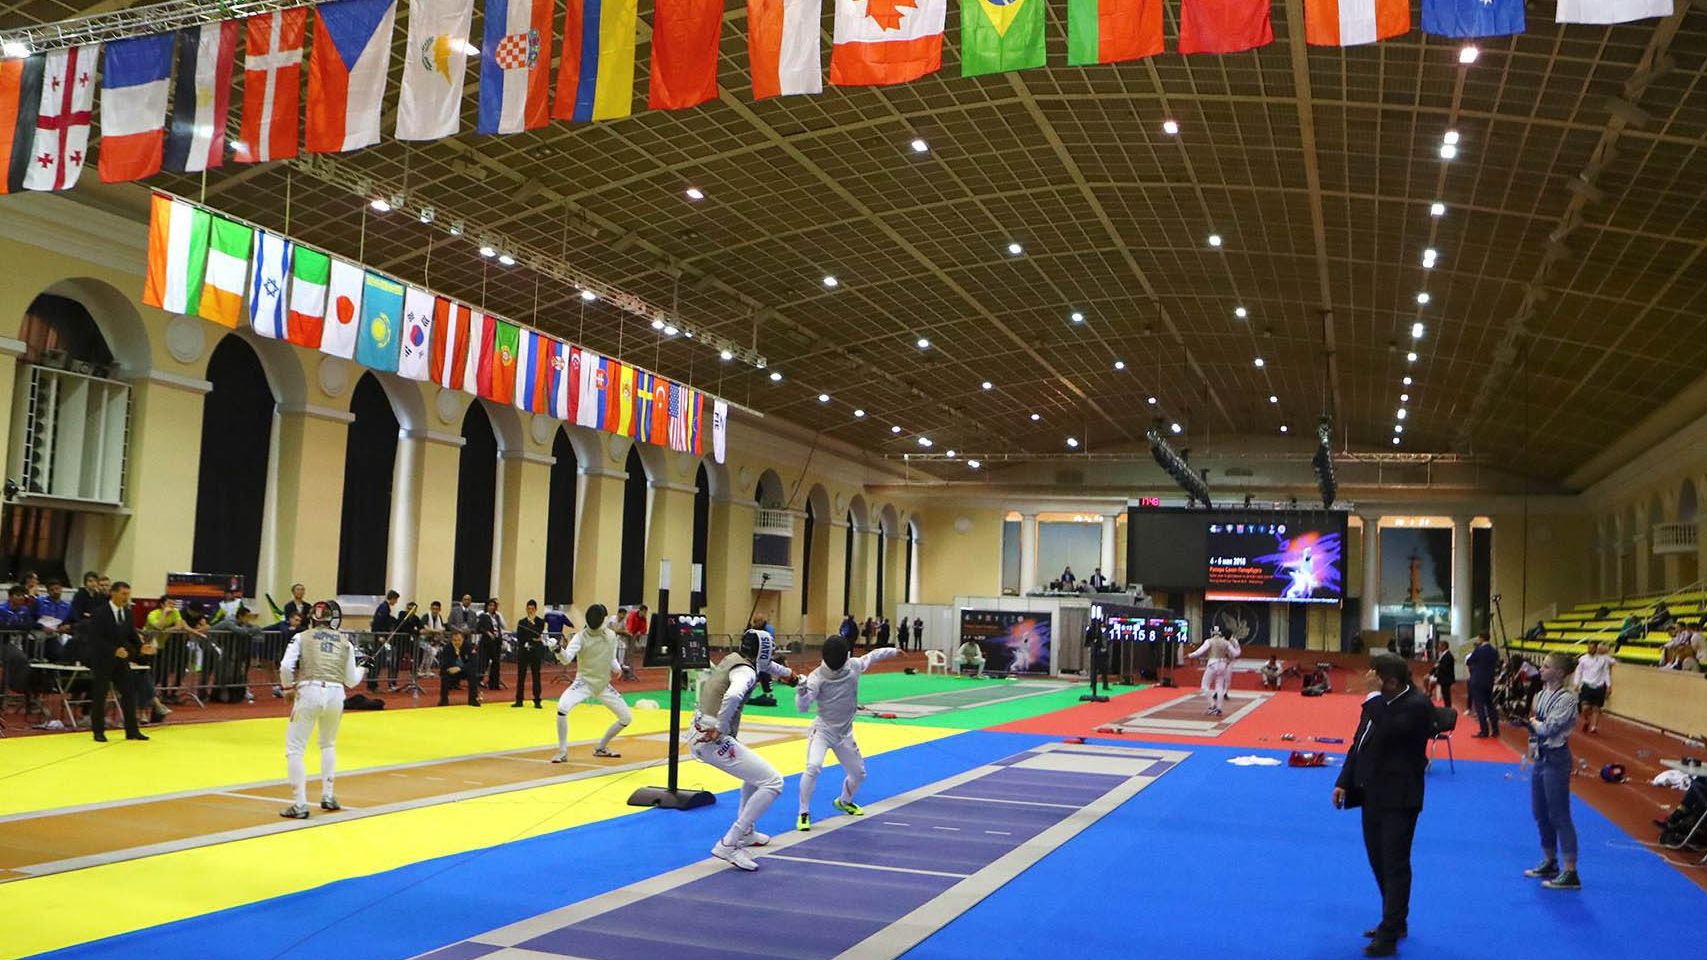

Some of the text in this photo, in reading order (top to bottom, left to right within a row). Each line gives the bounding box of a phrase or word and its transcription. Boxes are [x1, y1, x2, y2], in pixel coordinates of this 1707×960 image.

[1210, 557, 1214, 565] 4
[1218, 557, 1222, 565] 6
[1233, 557, 1246, 566] 2018
[1109, 630, 1121, 640] 11
[1149, 630, 1156, 641] 8
[1176, 632, 1188, 643] 14
[760, 636, 771, 660] DAVIS
